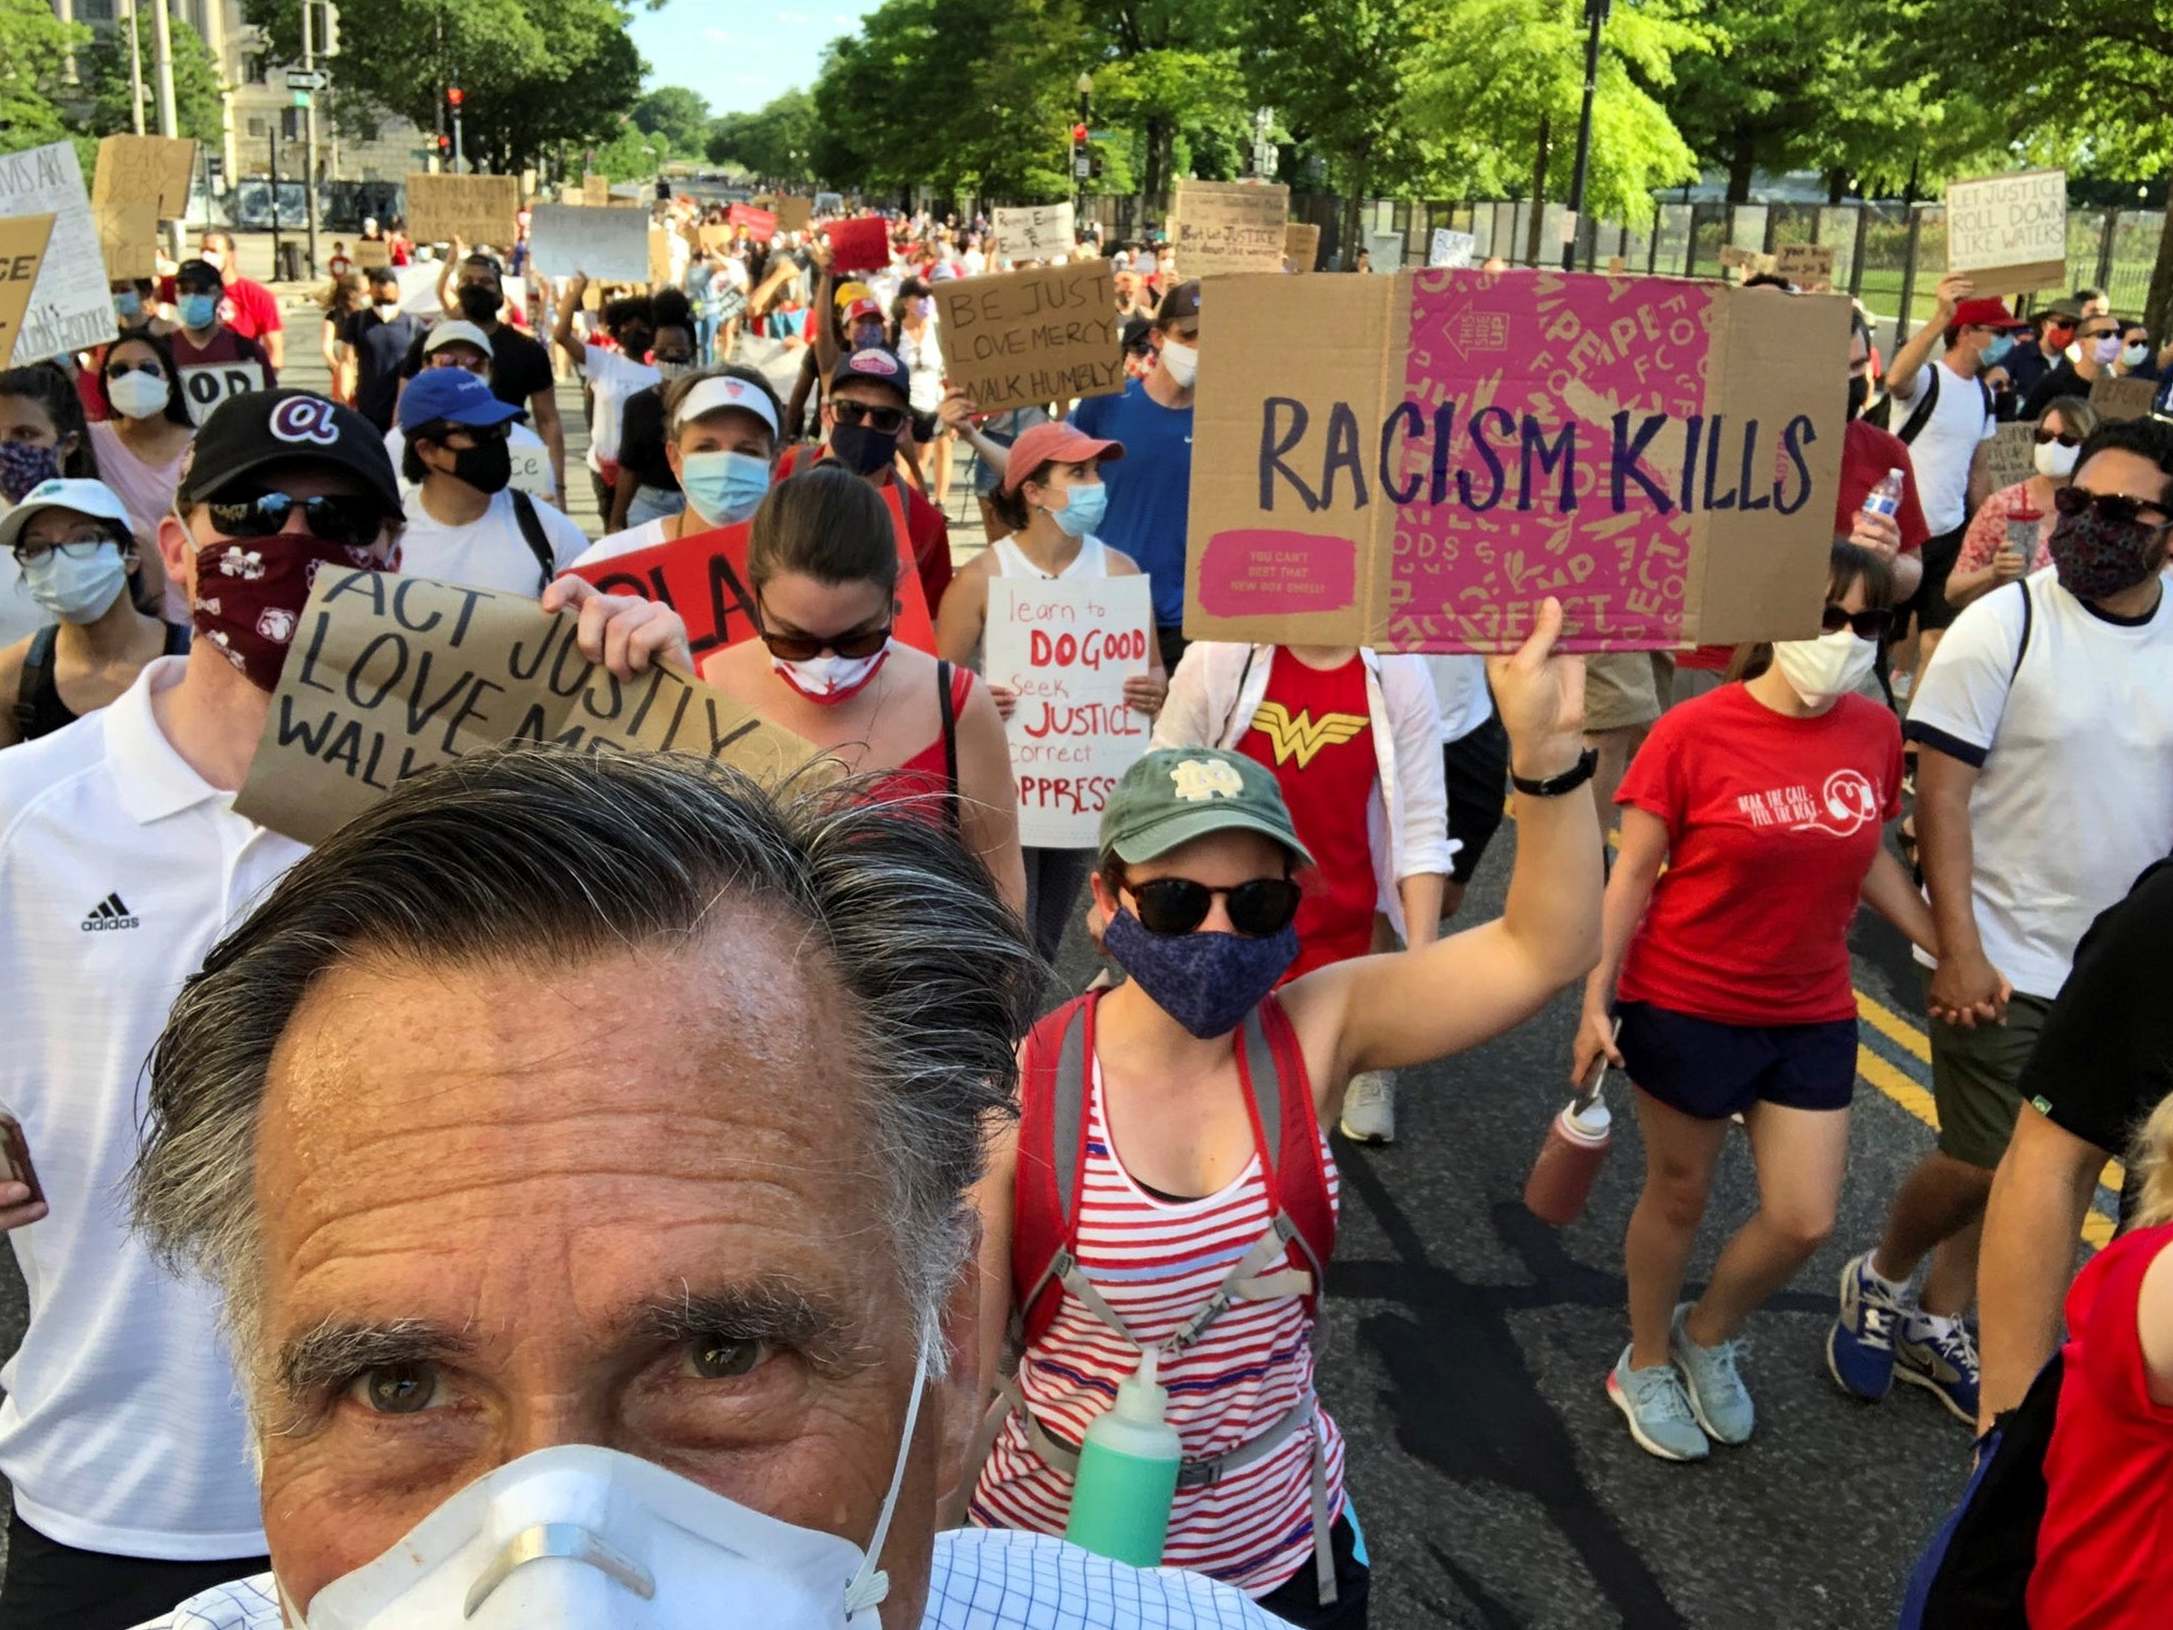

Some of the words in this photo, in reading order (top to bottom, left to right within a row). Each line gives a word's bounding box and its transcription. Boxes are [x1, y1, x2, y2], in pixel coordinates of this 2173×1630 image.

[1951, 188, 1980, 209] LET
[1985, 178, 2063, 205] JUSTICE
[1951, 209, 1999, 233] ROLL
[2008, 200, 2065, 227] DOWN
[1951, 230, 1994, 256] LIKE
[2000, 223, 2065, 249] WATERS
[949, 290, 1002, 329] BE
[1021, 275, 1107, 316] JUST
[950, 328, 1026, 364] LOVE
[1031, 316, 1115, 349] MERCY
[1459, 316, 1474, 346] THIS
[1475, 316, 1489, 346] SIDE
[1490, 316, 1505, 346] UP
[1029, 360, 1120, 395] HUMBLY
[1259, 395, 1578, 513] RACISM
[1611, 409, 1817, 517] KILLS
[1249, 551, 1273, 563] YOU
[321, 571, 496, 648] ACT
[1009, 589, 1076, 623] learn
[1087, 601, 1107, 618] to
[299, 611, 505, 759] LOVE
[1024, 702, 1142, 738] JUSTICE
[1010, 742, 1092, 764] correct
[80, 916, 140, 932] adidas
